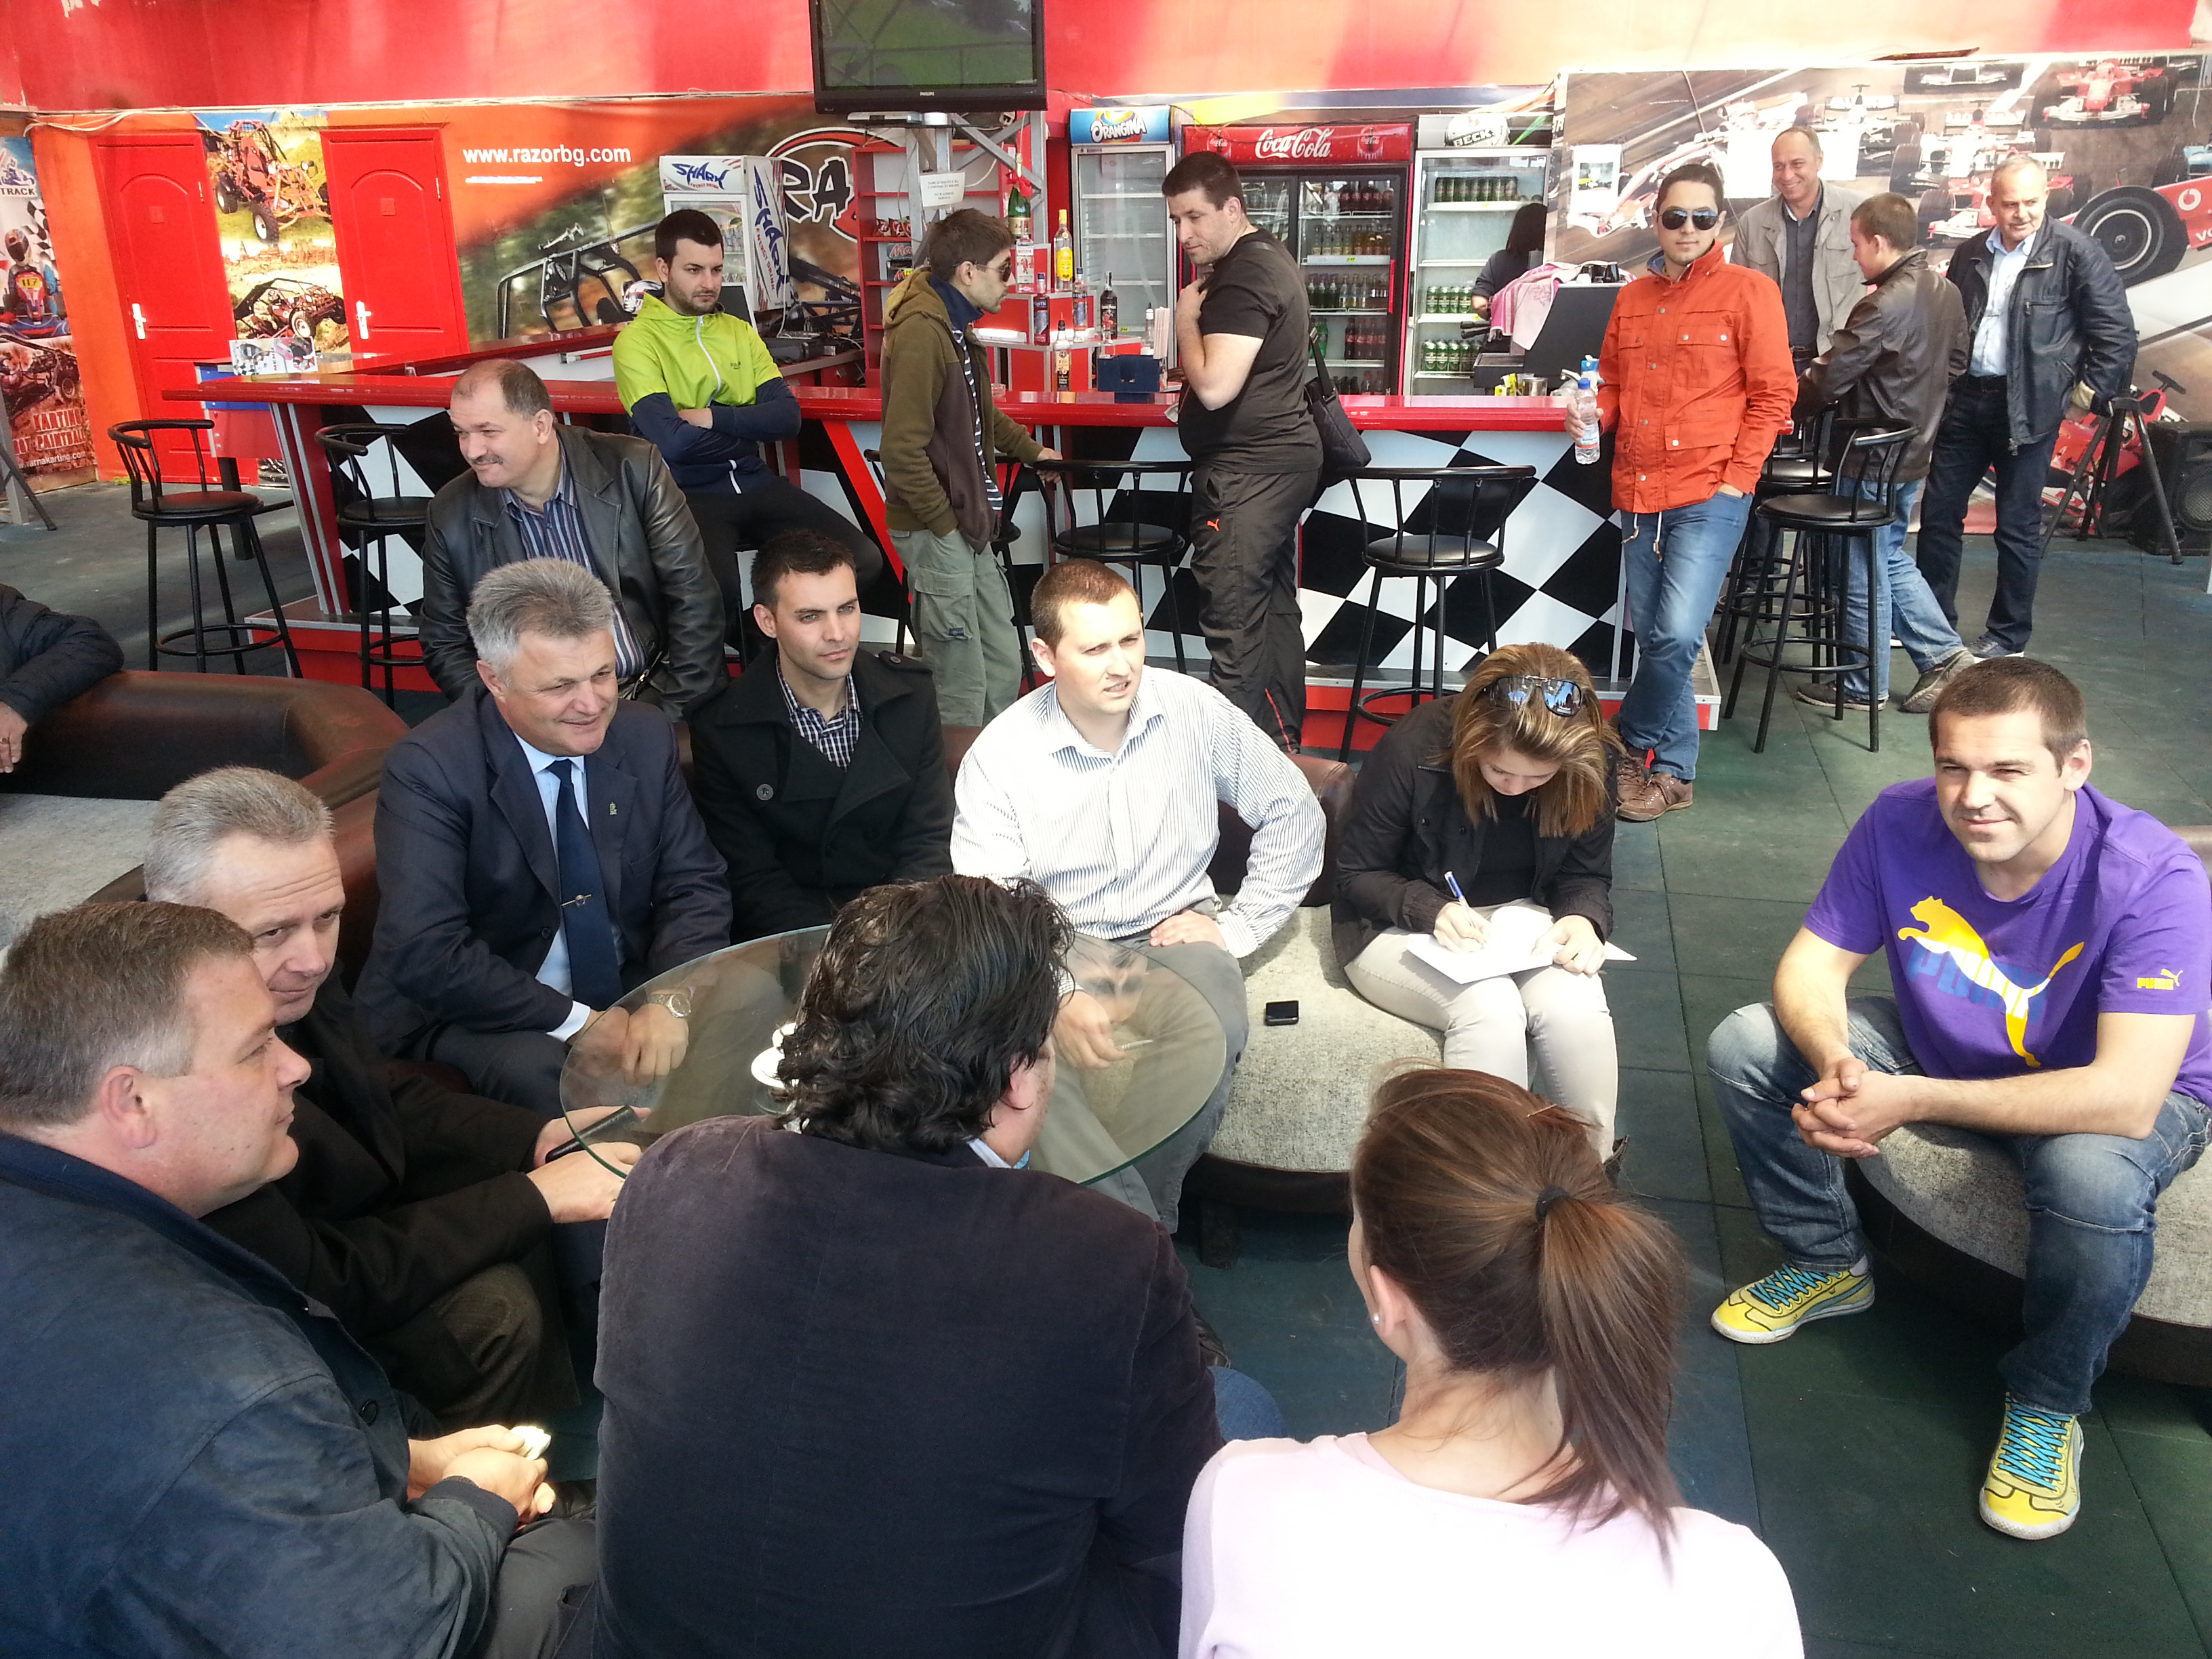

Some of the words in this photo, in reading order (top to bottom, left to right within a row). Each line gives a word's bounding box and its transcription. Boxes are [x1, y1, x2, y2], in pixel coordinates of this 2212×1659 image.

[1090, 117, 1147, 143] ORANGINA
[463, 144, 631, 167] www.razorbg.com
[1255, 128, 1334, 159] Coca-Cola
[672, 162, 730, 190] SHARK
[1, 188, 35, 196] TRACK
[754, 165, 790, 298] SHARK
[22, 278, 37, 287] 117
[33, 408, 82, 432] KARTING
[37, 429, 86, 451] PAINTBALL
[1906, 936, 2048, 1024] PUMA
